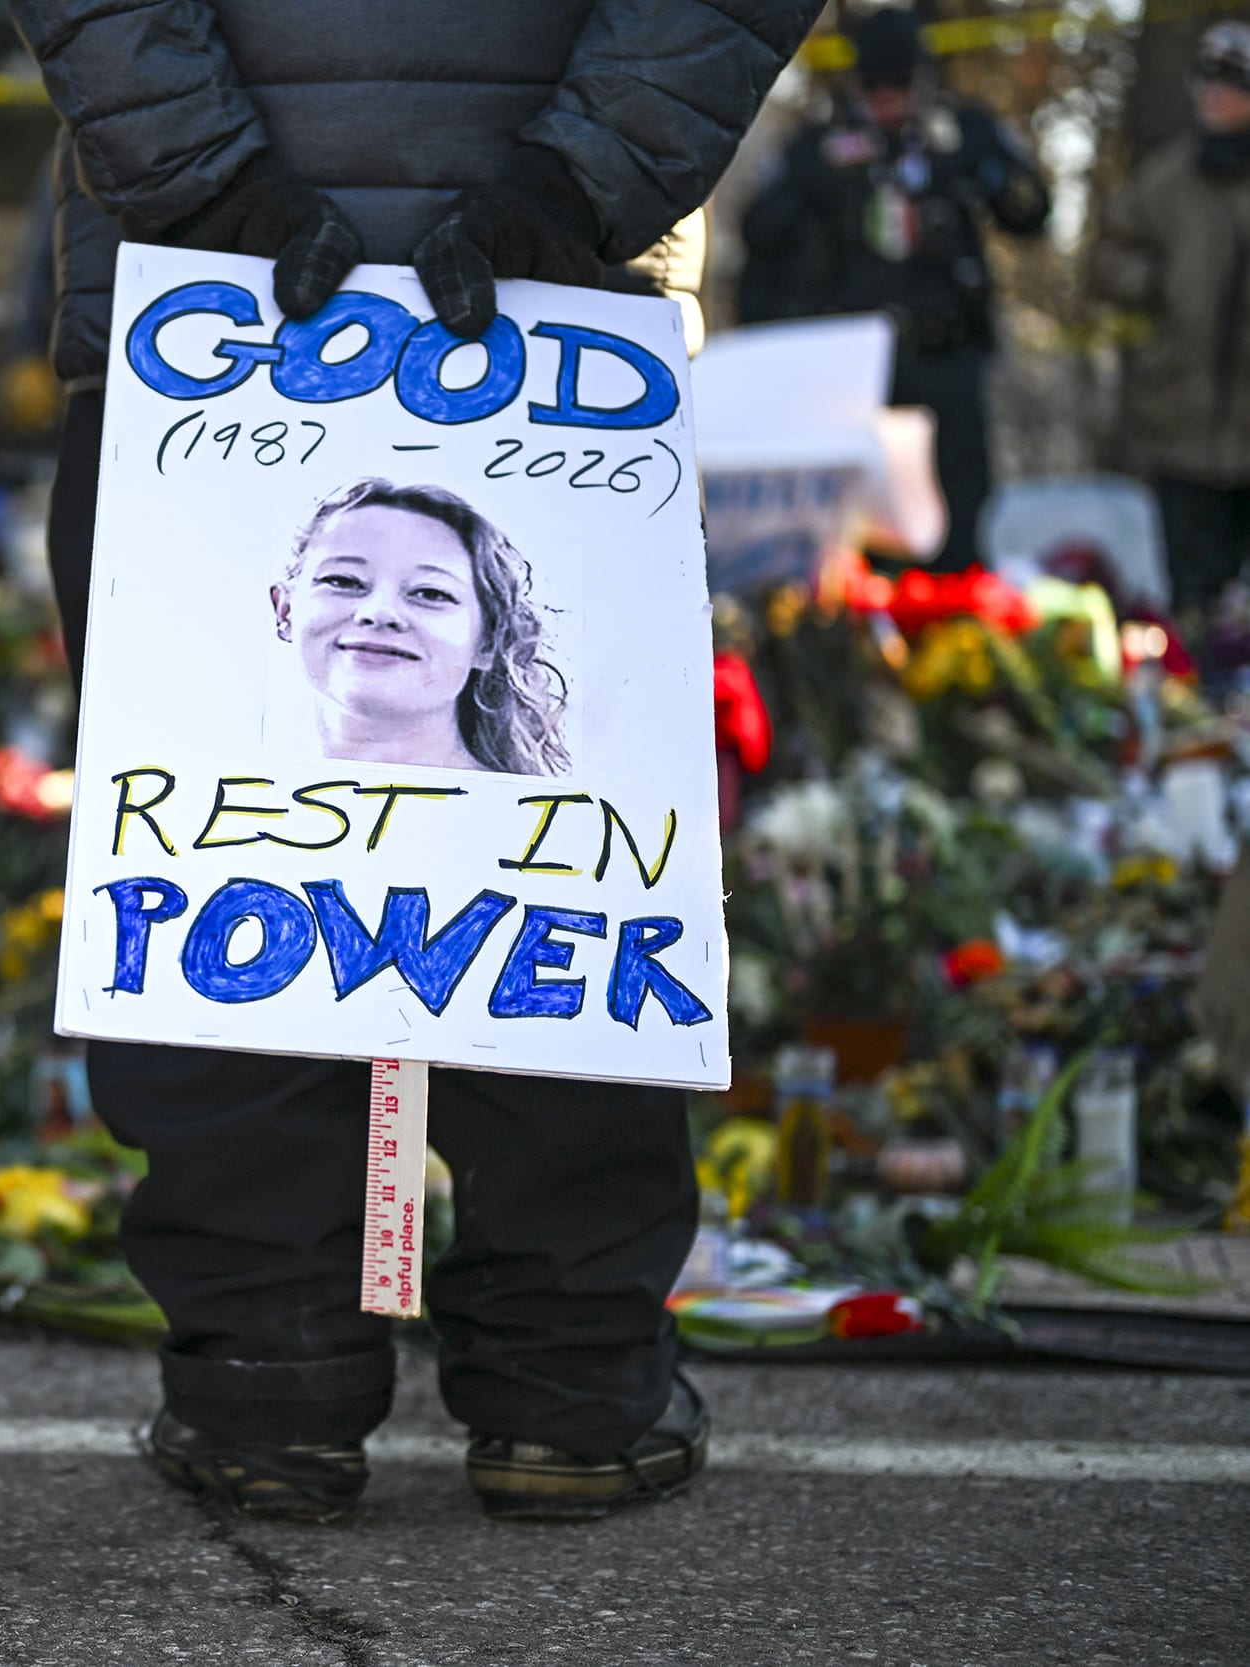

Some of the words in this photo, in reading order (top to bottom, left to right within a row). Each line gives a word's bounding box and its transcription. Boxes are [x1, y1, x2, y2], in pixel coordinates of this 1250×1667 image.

[125, 281, 681, 431] GOOD
[157, 410, 327, 475] (1987
[484, 438, 682, 518] 2026)
[111, 765, 469, 857] REST
[498, 792, 678, 890] IN
[92, 877, 714, 1032] POWER
[385, 1096, 399, 1115] 13
[383, 1140, 397, 1158] 12
[382, 1185, 396, 1203] 11
[380, 1229, 394, 1248] 10
[398, 1198, 415, 1252] place.
[378, 1275, 392, 1288] 9
[396, 1256, 414, 1309] elpful
